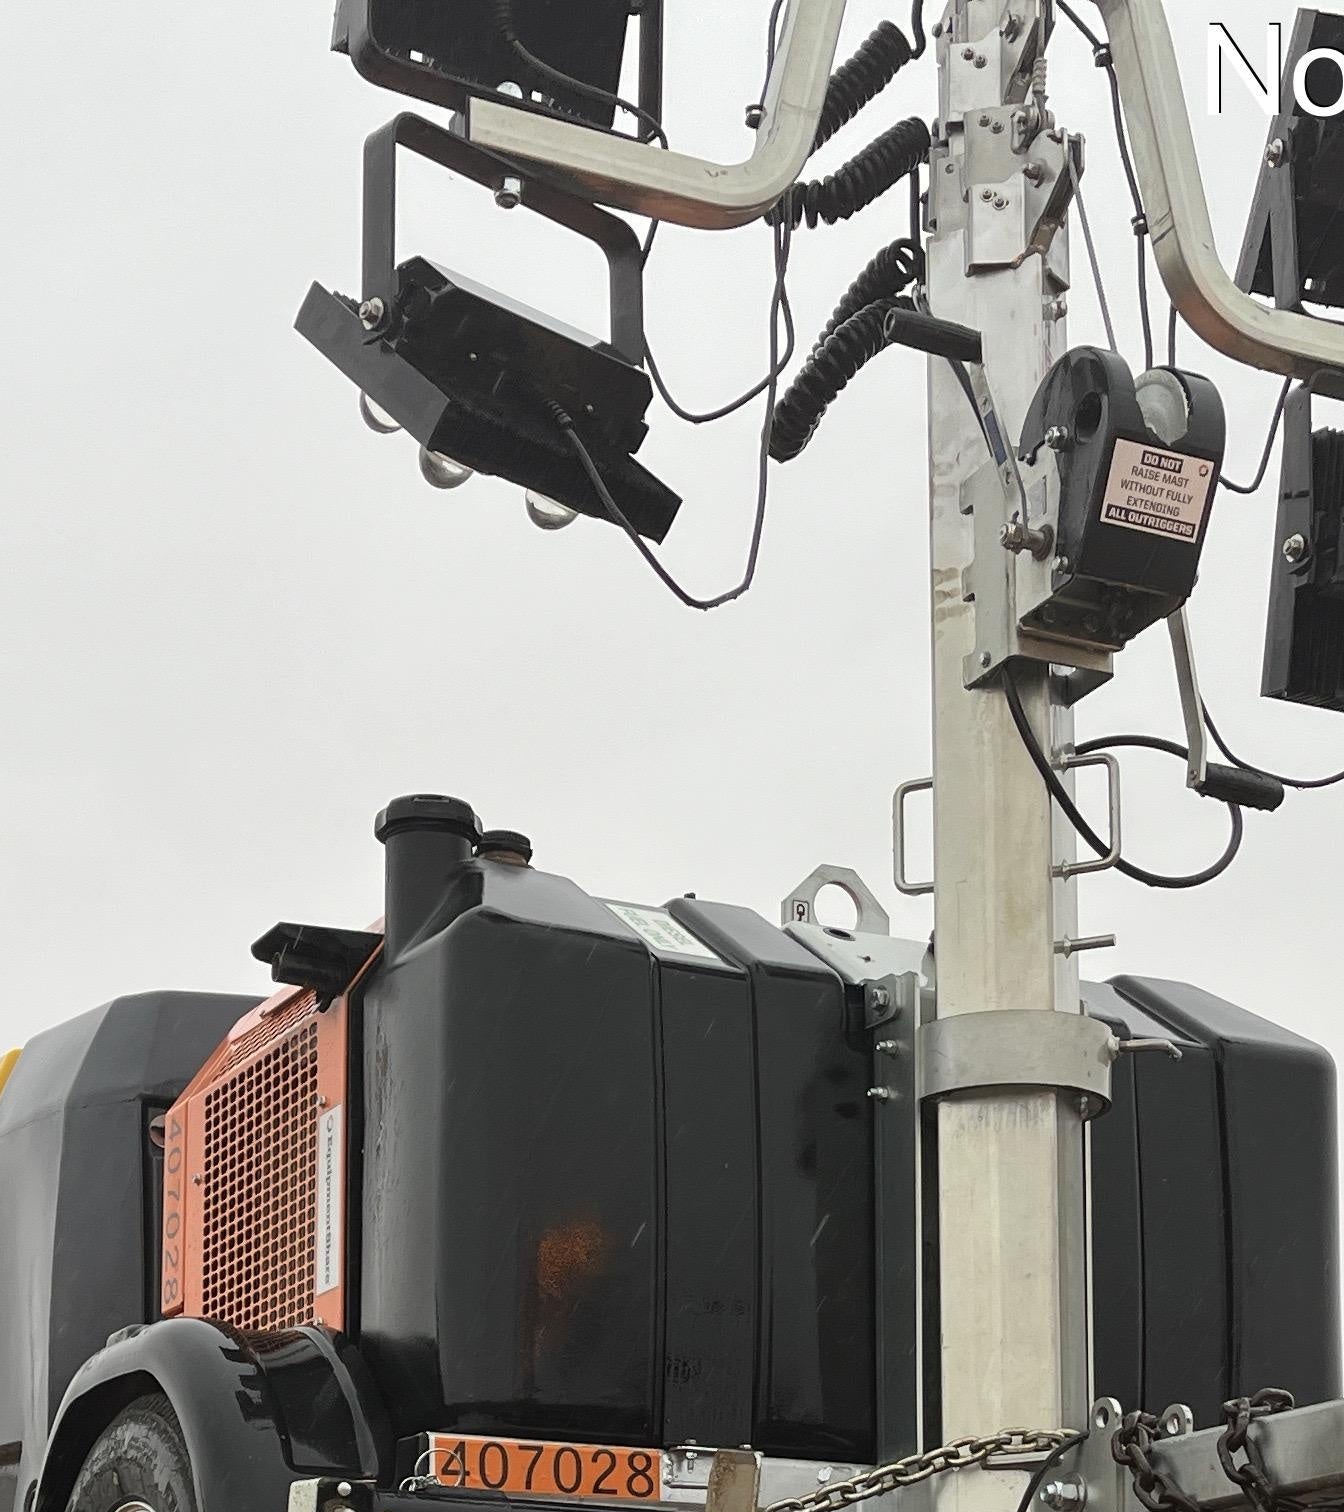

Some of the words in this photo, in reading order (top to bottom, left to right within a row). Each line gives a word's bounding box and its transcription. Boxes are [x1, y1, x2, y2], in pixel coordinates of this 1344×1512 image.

[1143, 453, 1159, 466] DO
[1159, 456, 1183, 472] NOT
[1130, 465, 1160, 482] RAISE
[1162, 472, 1190, 489] MAST
[1120, 478, 1166, 497] WITHOUT
[1165, 489, 1194, 505] FULLY
[1126, 495, 1181, 517] EXTENDING
[1108, 506, 1127, 520] ALL
[1127, 510, 1193, 536] OUTRIGGERS
[164, 1117, 182, 1305] 407028
[441, 1440, 654, 1498] 407028
